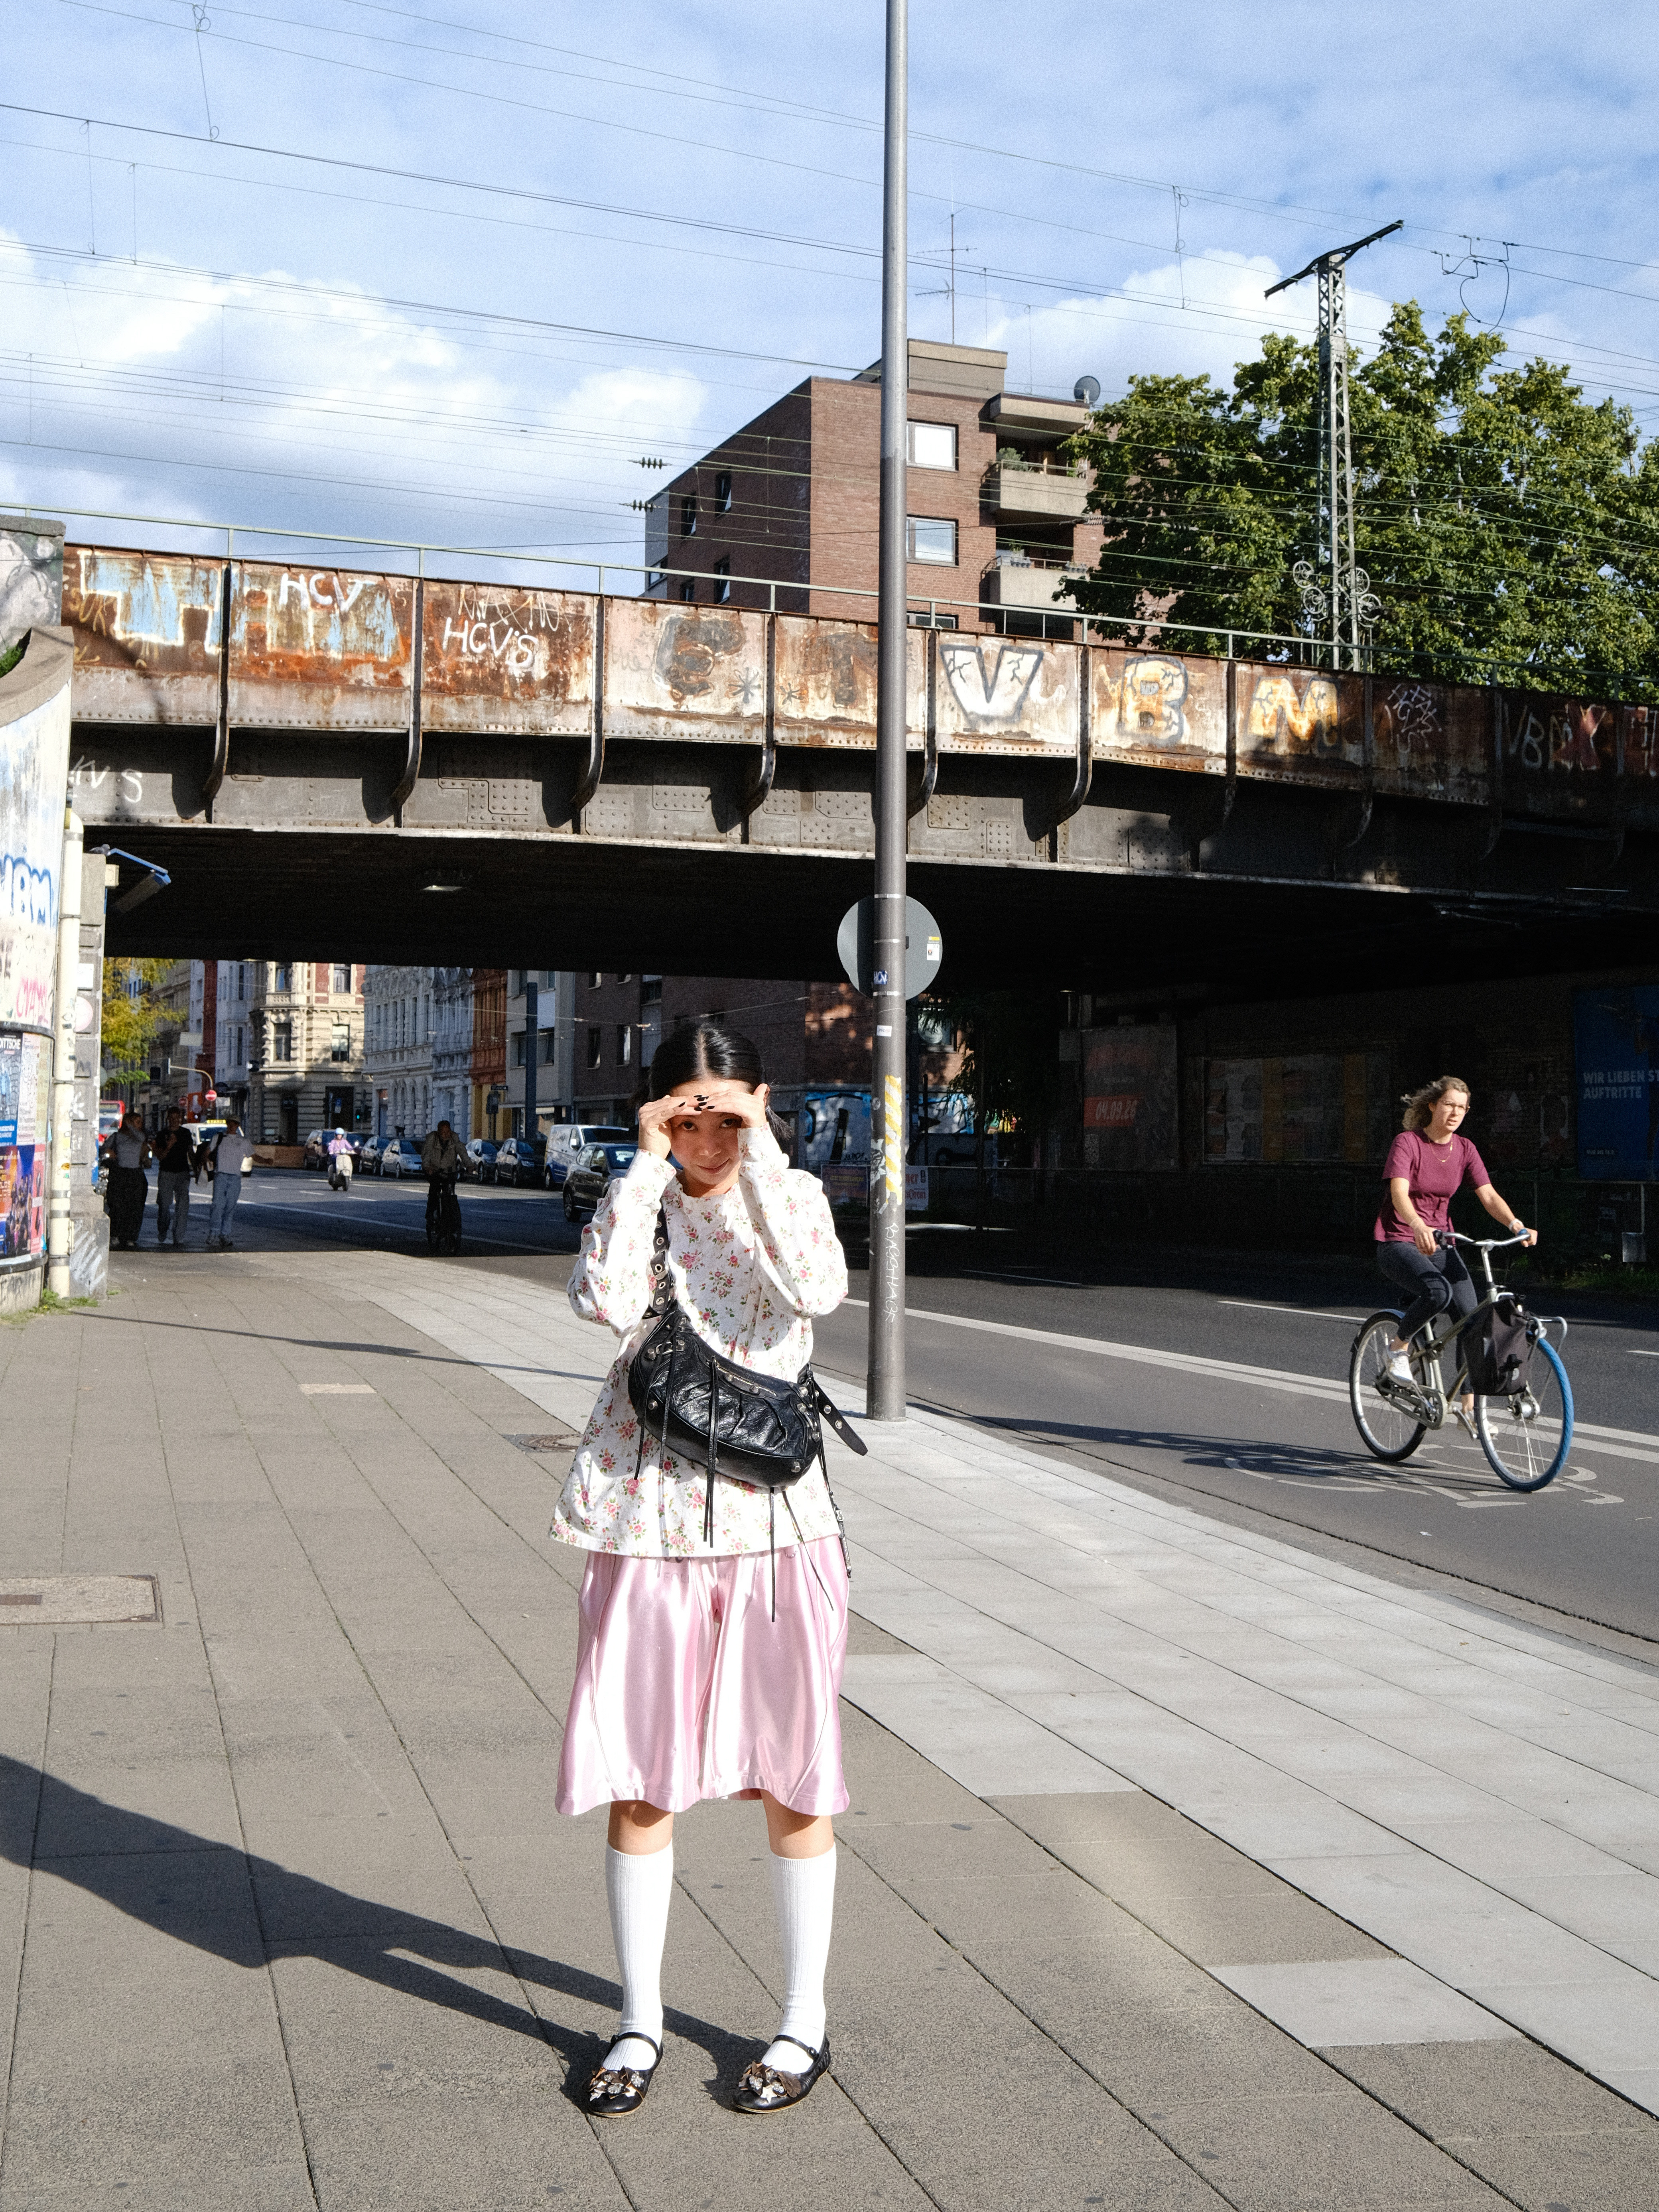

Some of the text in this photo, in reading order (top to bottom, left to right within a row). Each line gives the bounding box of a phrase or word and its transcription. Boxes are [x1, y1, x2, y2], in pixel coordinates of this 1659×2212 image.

[1583, 1072, 1604, 1084] WIR
[1608, 1070, 1645, 1083] LIEBEN
[1584, 1086, 1642, 1099] AUFTRITTE
[906, 1173, 918, 1186] ner
